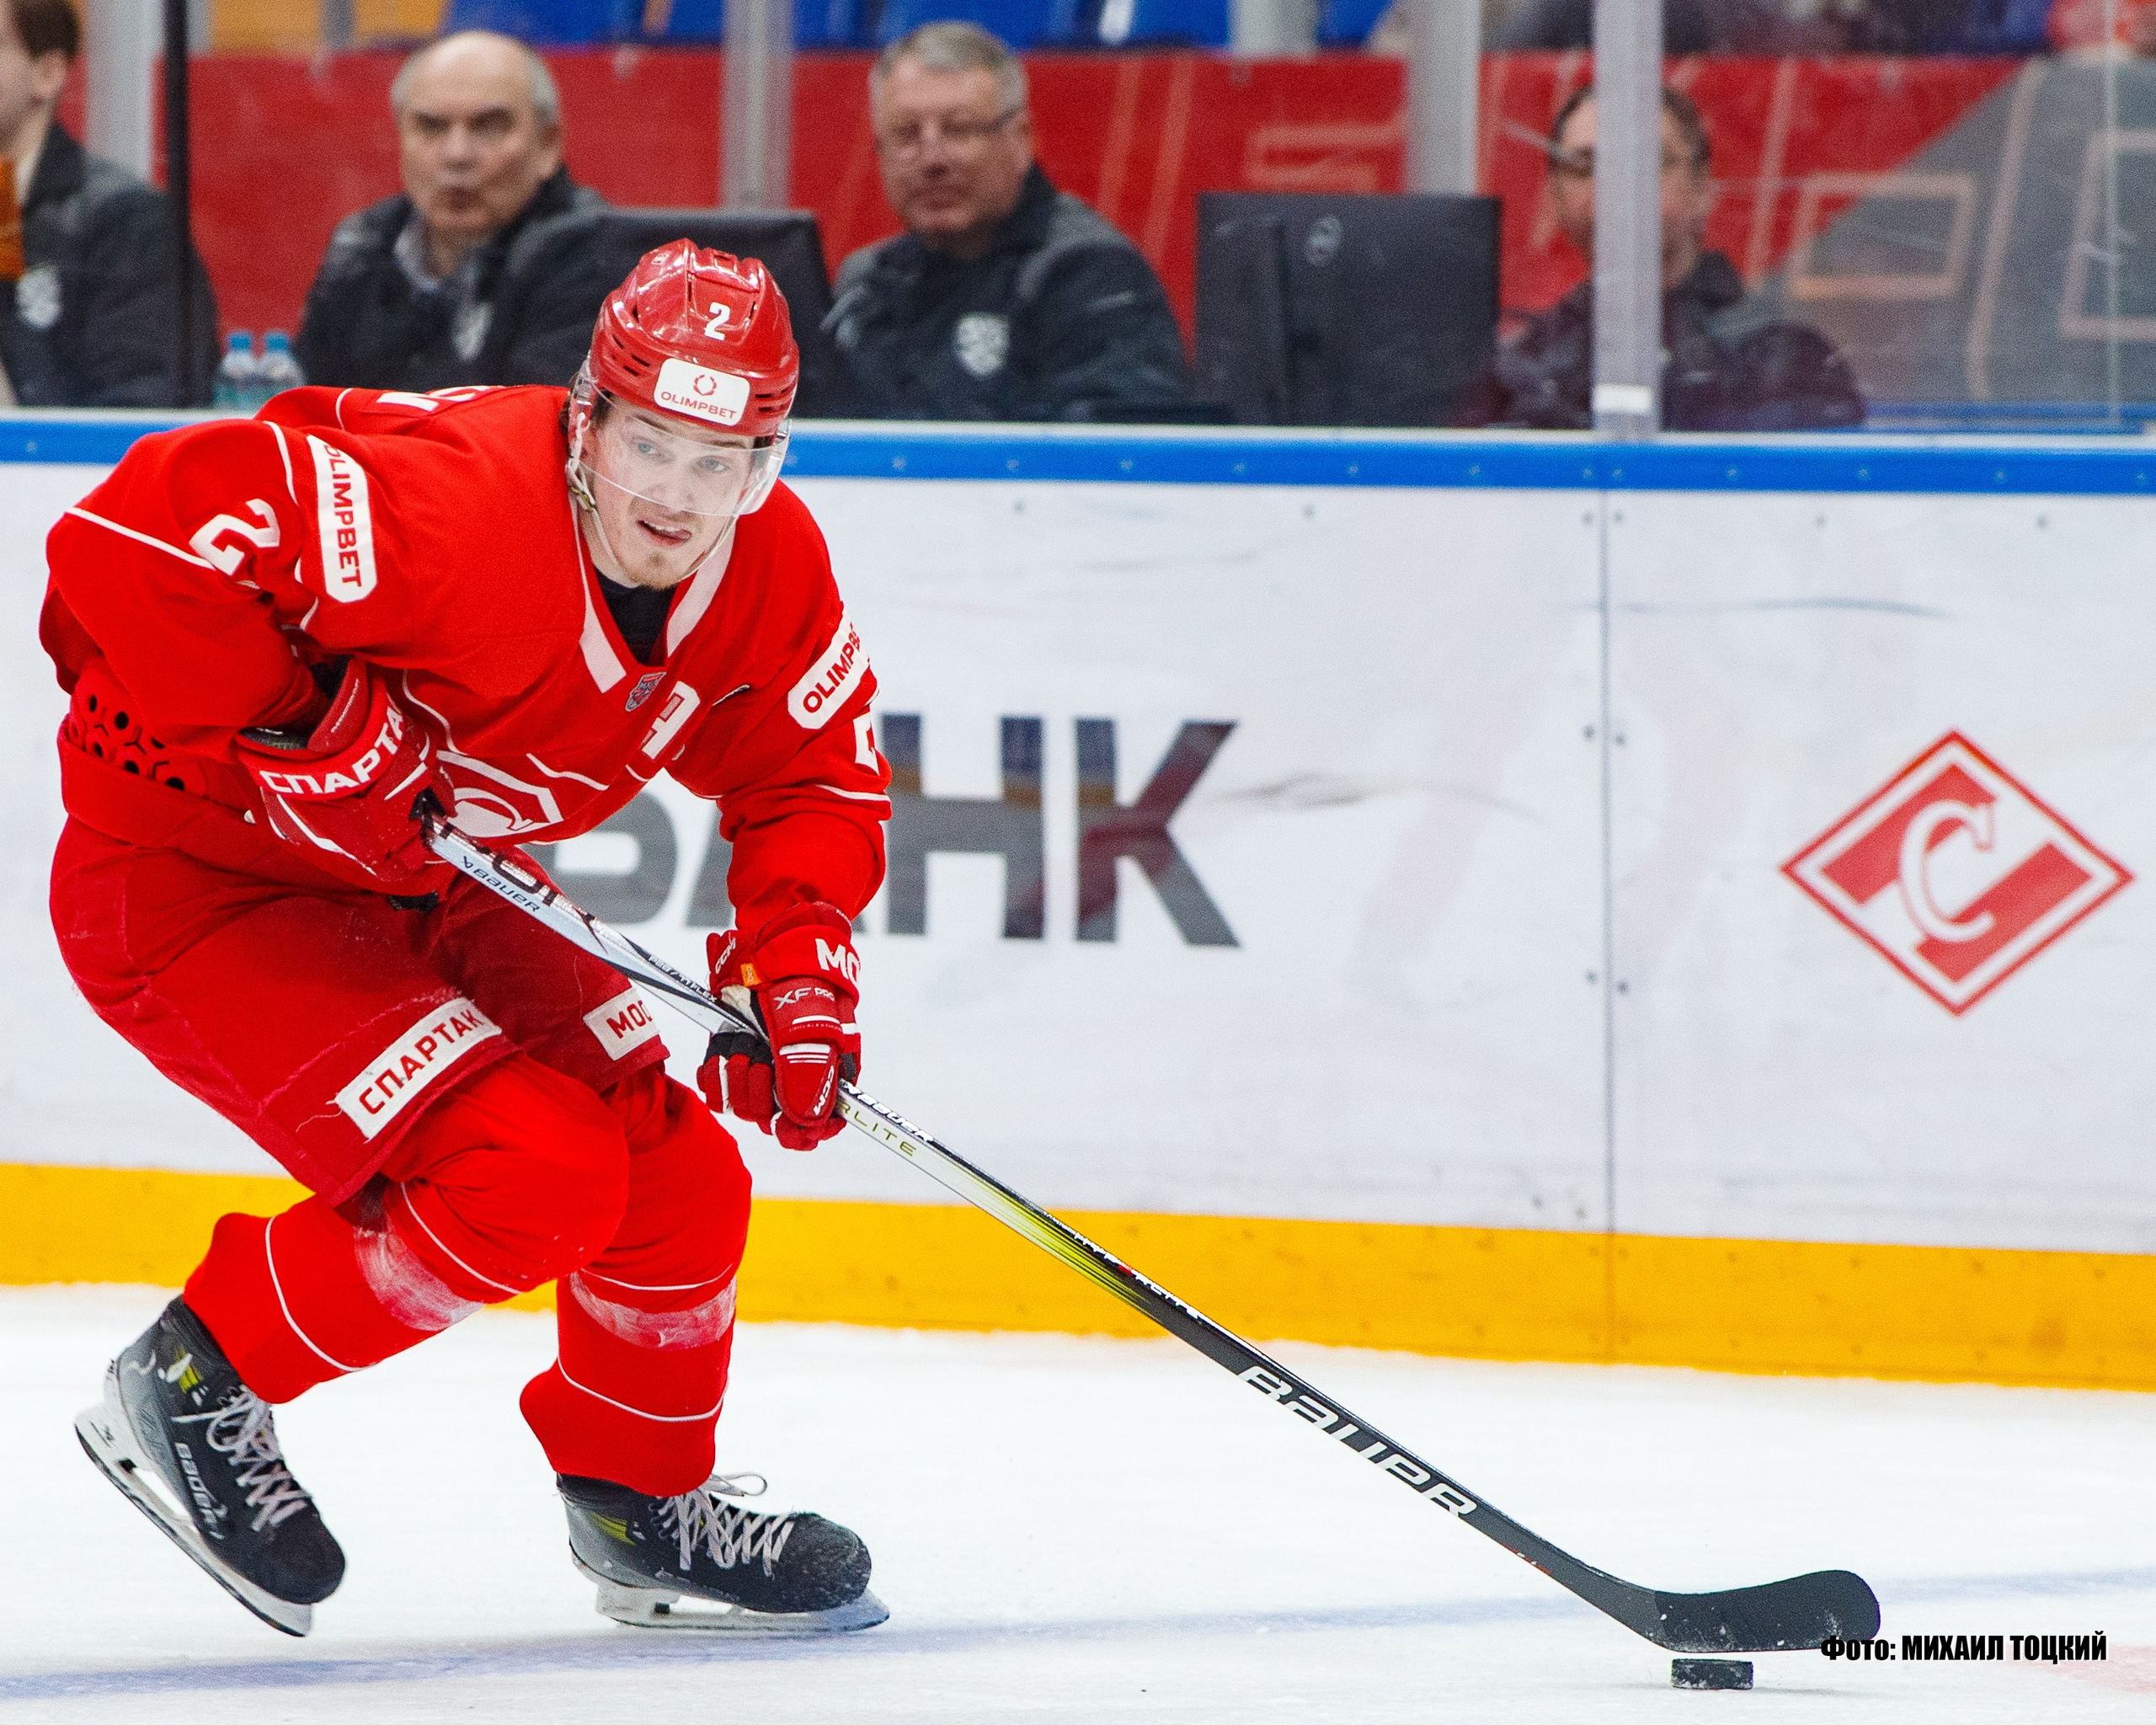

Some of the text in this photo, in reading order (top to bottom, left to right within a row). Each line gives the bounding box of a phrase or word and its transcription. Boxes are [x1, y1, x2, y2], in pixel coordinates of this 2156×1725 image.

[704, 302, 731, 341] 2
[660, 390, 737, 419] OLIMPBET
[189, 498, 280, 577] 2
[323, 445, 361, 588] OLIMPBET
[802, 622, 861, 713] OLIMPB
[515, 713, 1243, 950] БНК
[473, 868, 541, 912] BAUER
[773, 987, 812, 1011] XF
[358, 1008, 484, 1116] СПАРТАК
[1238, 1365, 1478, 1518] BAUER
